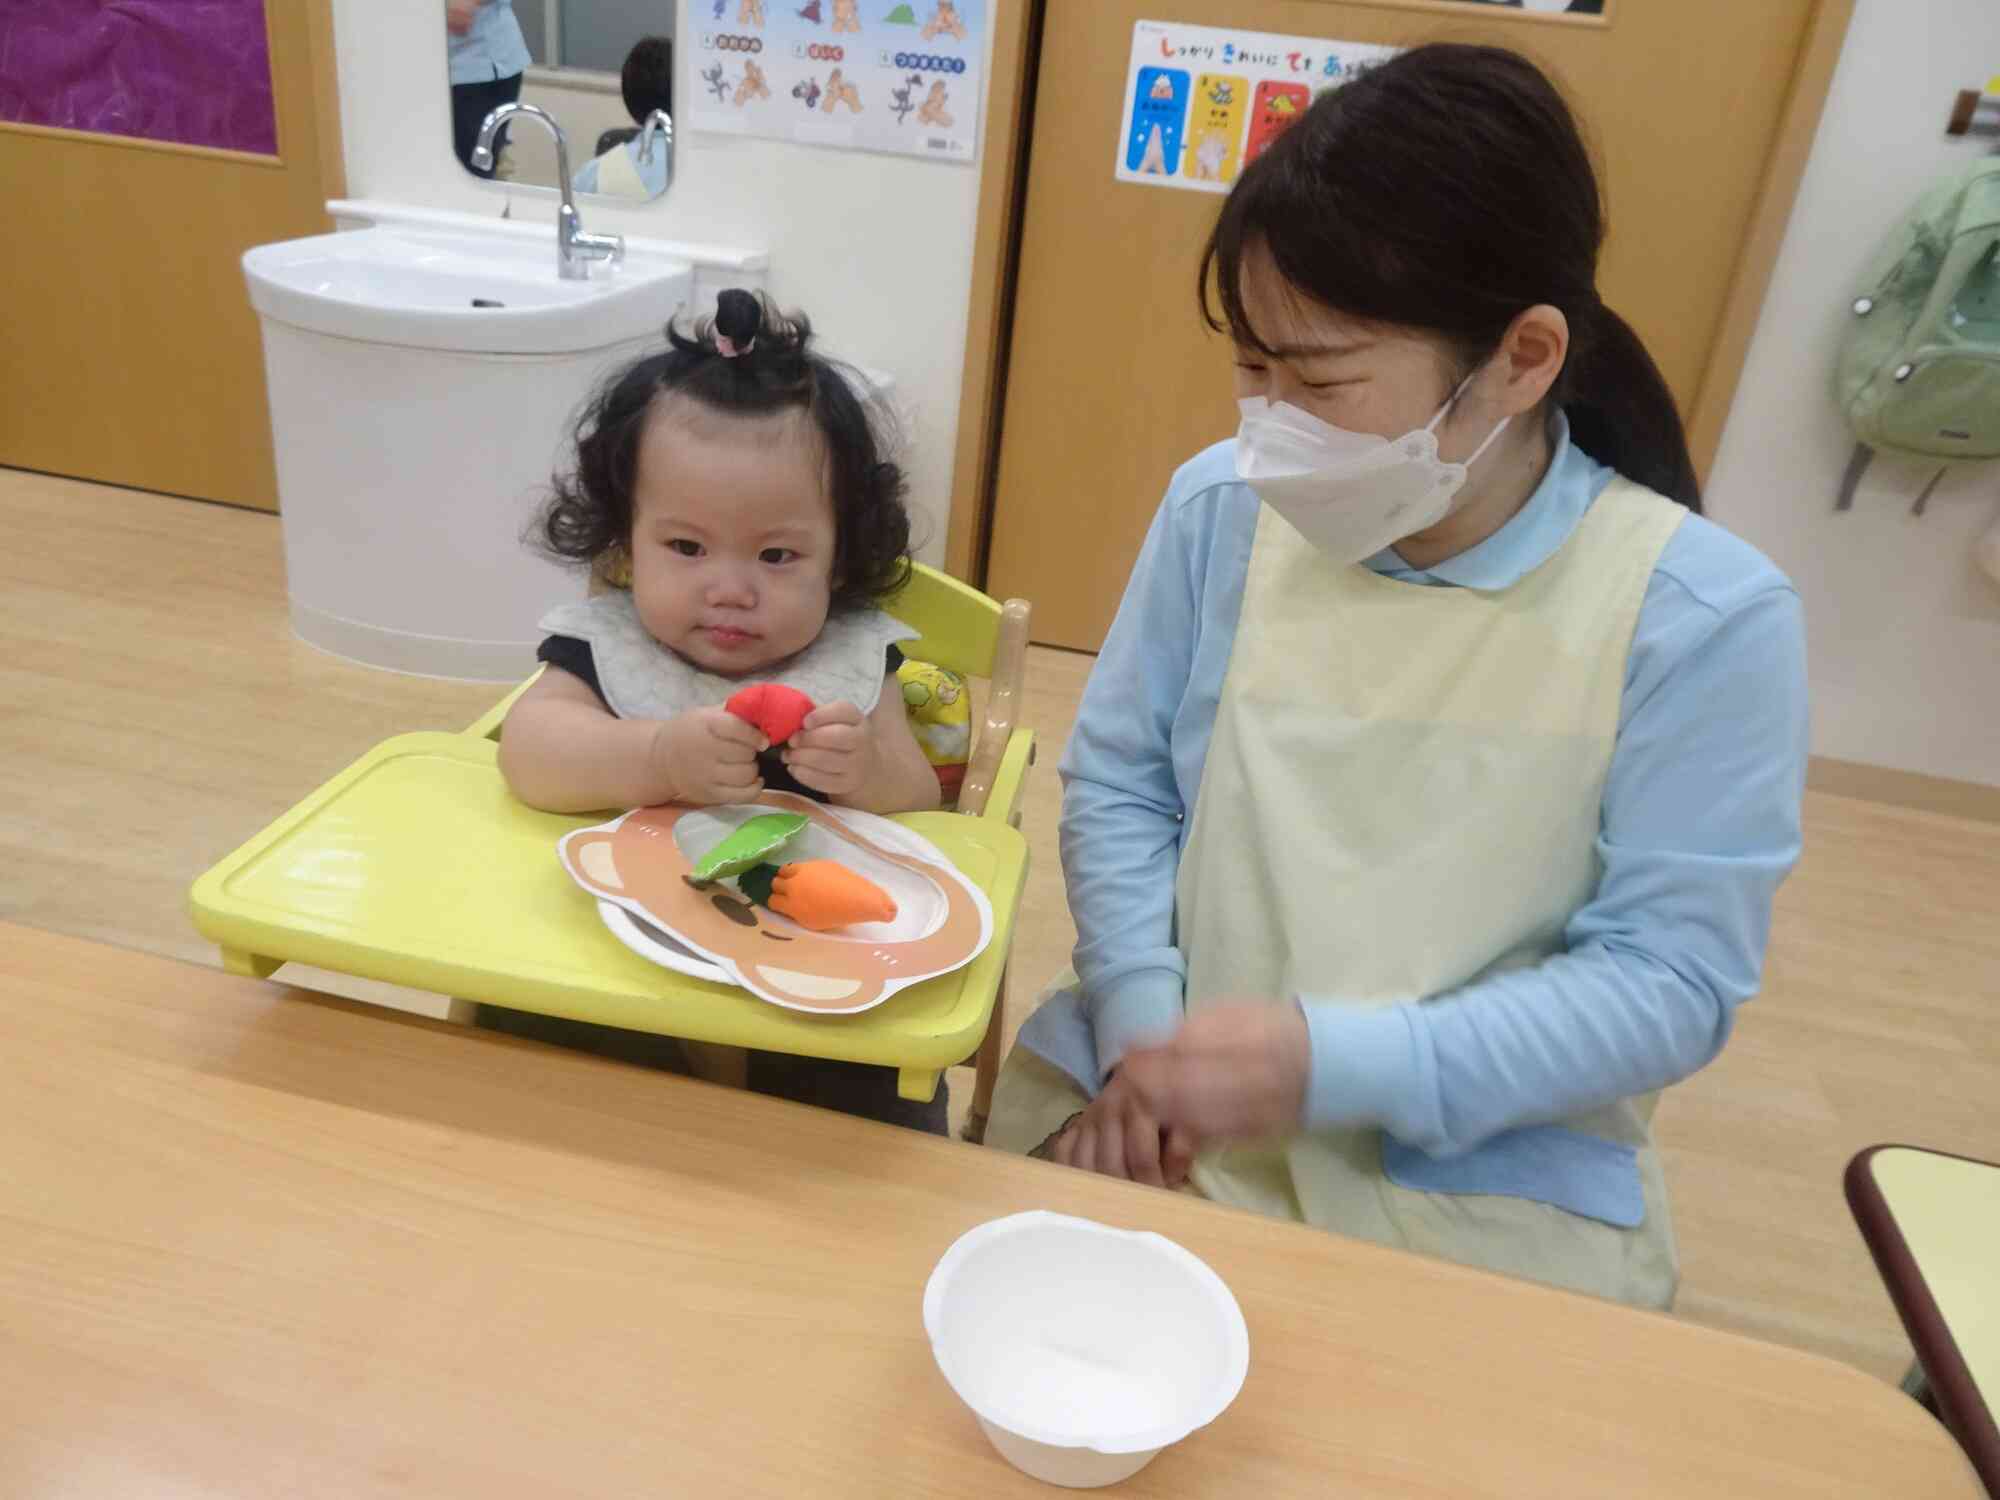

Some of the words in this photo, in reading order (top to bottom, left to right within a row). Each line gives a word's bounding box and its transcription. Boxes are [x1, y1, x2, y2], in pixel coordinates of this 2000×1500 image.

[1161, 37, 1214, 59] しっかり
[1222, 43, 1278, 66] きれいに
